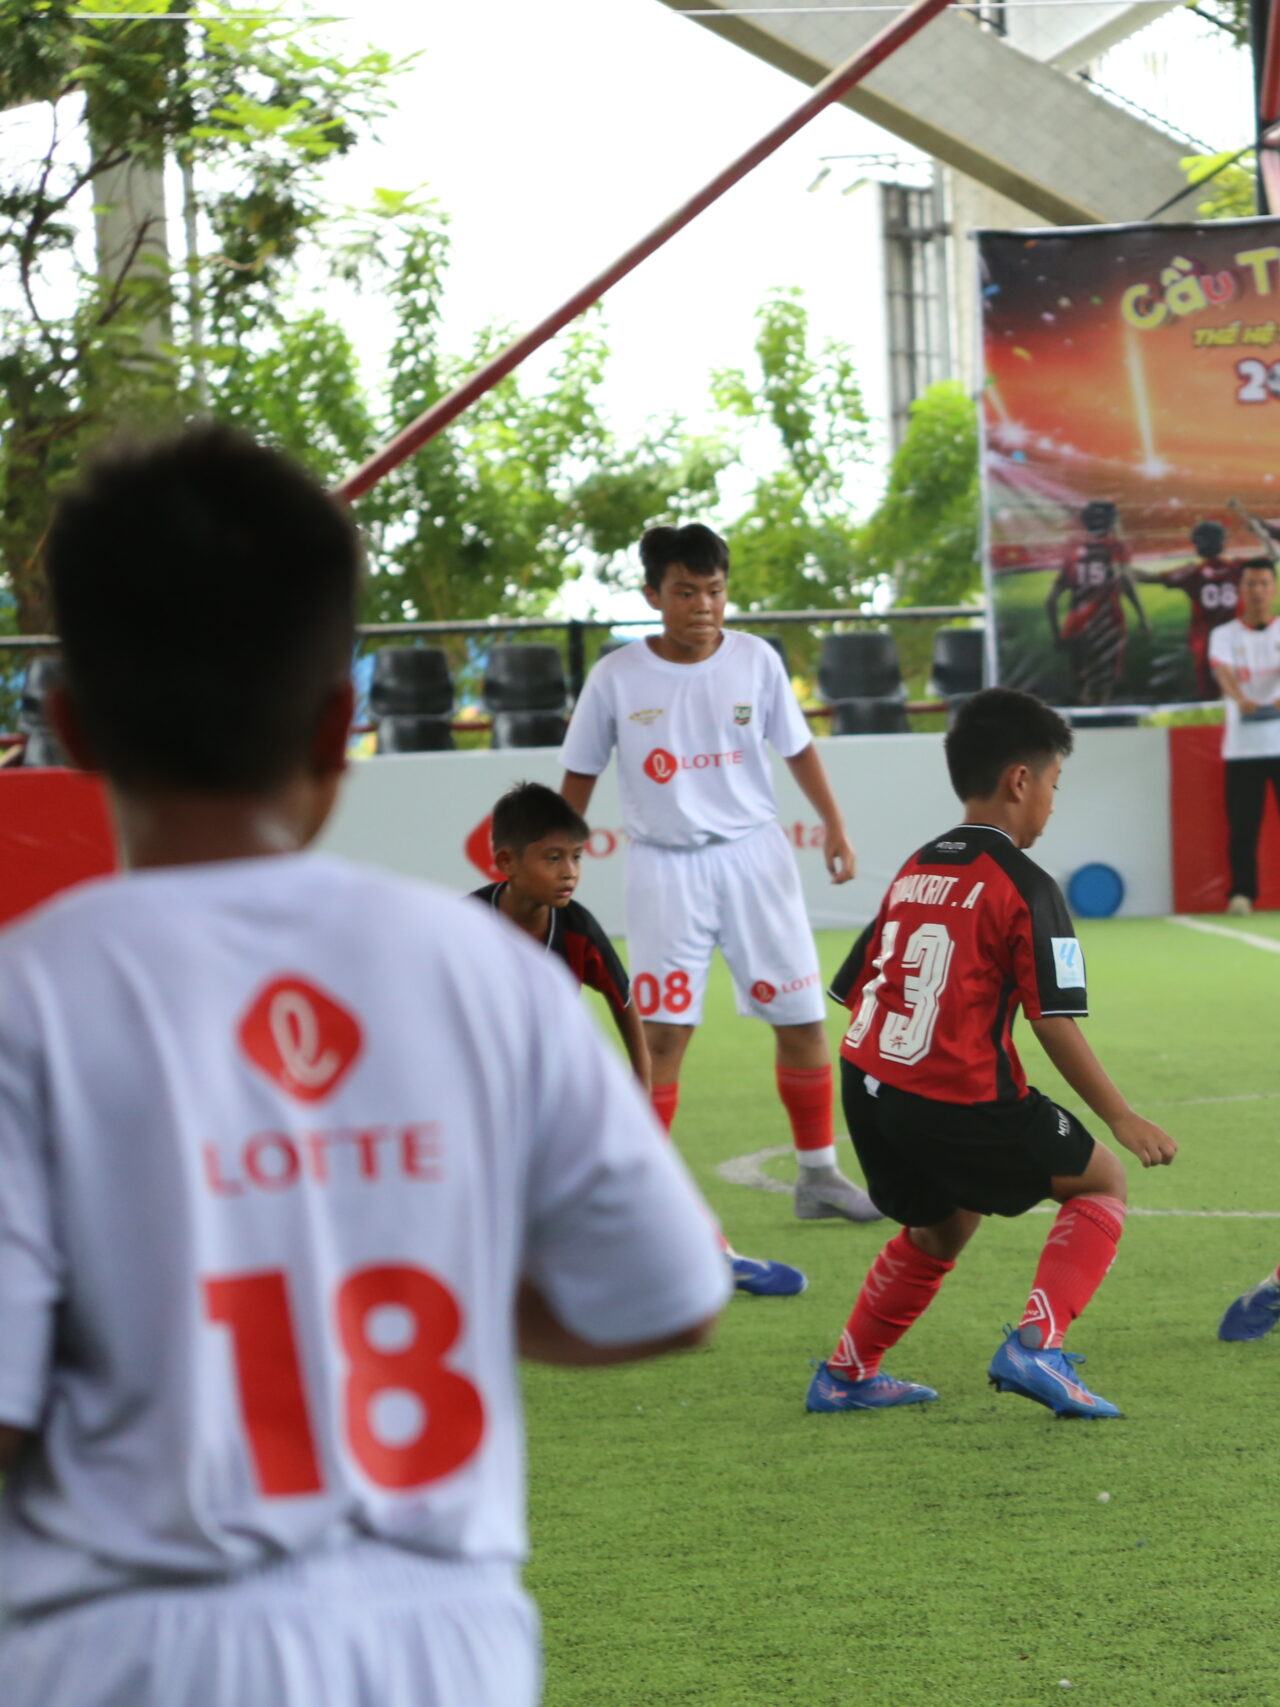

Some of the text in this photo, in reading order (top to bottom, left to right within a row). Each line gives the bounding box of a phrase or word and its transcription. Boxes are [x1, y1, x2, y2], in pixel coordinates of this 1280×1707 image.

[1121, 256, 1235, 328] Cầu
[680, 749, 744, 770] LOTTE
[632, 970, 693, 1017] 08
[844, 920, 955, 1067] 13
[205, 1120, 444, 1198] LOTTE
[200, 1262, 490, 1501] 18
